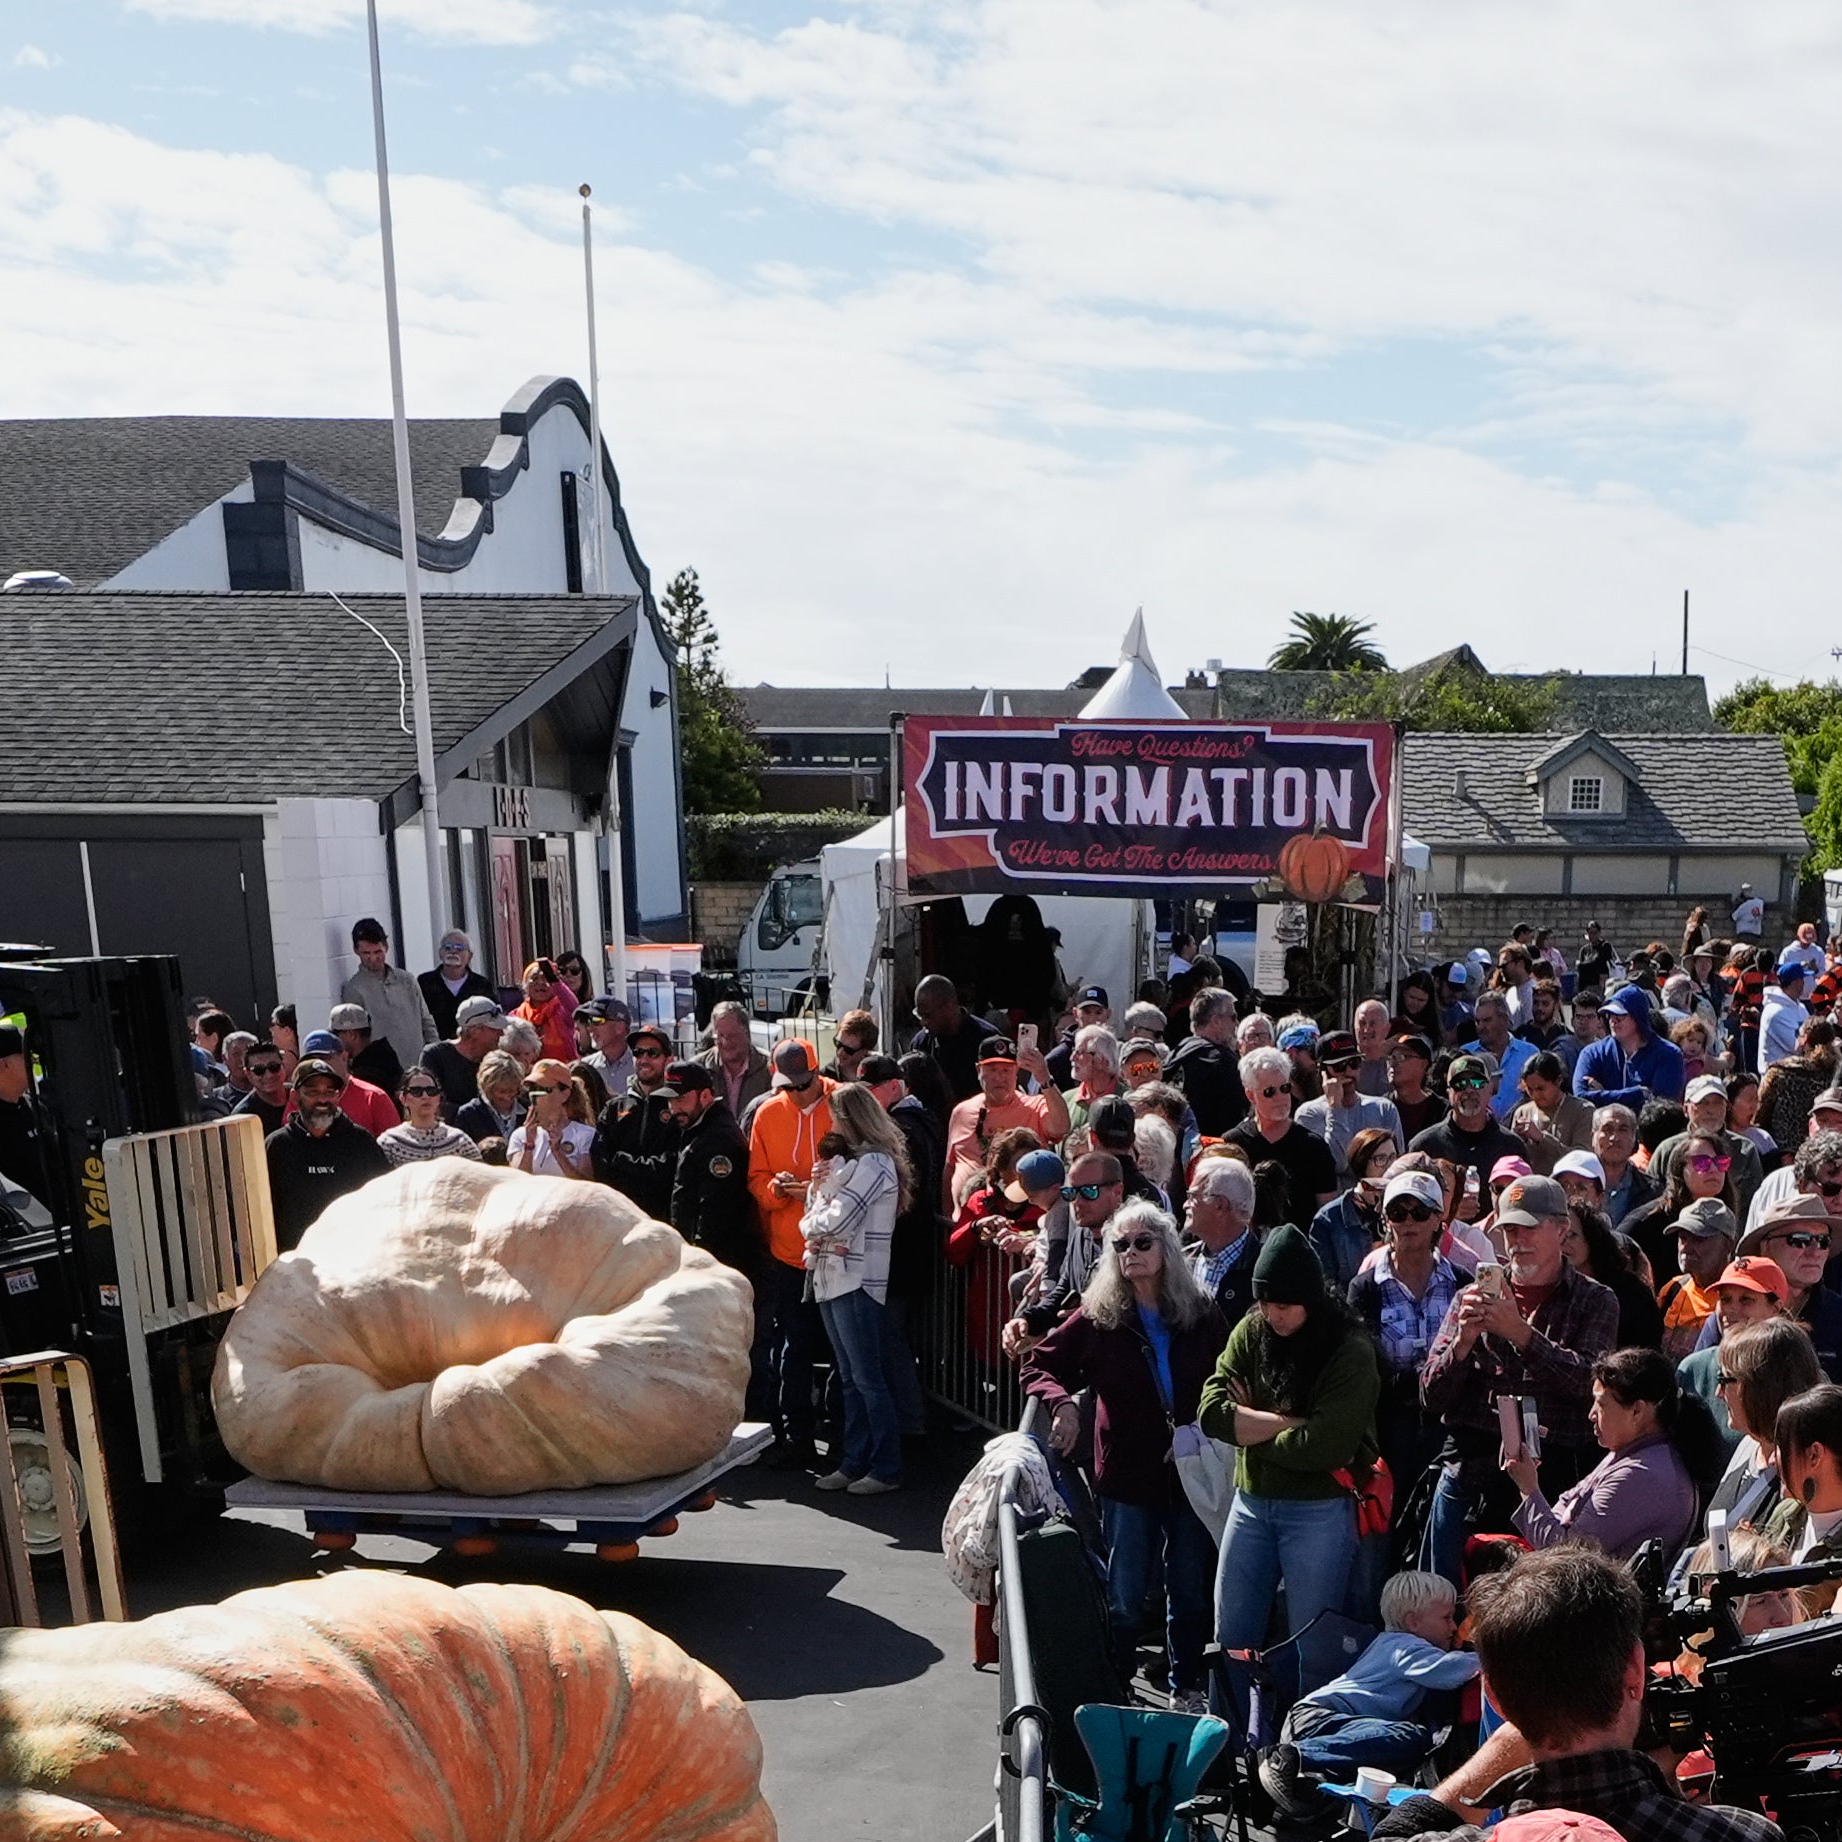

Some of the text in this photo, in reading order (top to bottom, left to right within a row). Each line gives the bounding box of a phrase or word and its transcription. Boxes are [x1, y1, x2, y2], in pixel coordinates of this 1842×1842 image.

[1071, 731, 1255, 765] Have Questions?
[944, 761, 1353, 830] INFORMATION
[1008, 839, 1080, 867] We've
[1084, 843, 1122, 869] Got
[1123, 844, 1165, 869] The
[80, 1155, 112, 1231] Yale
